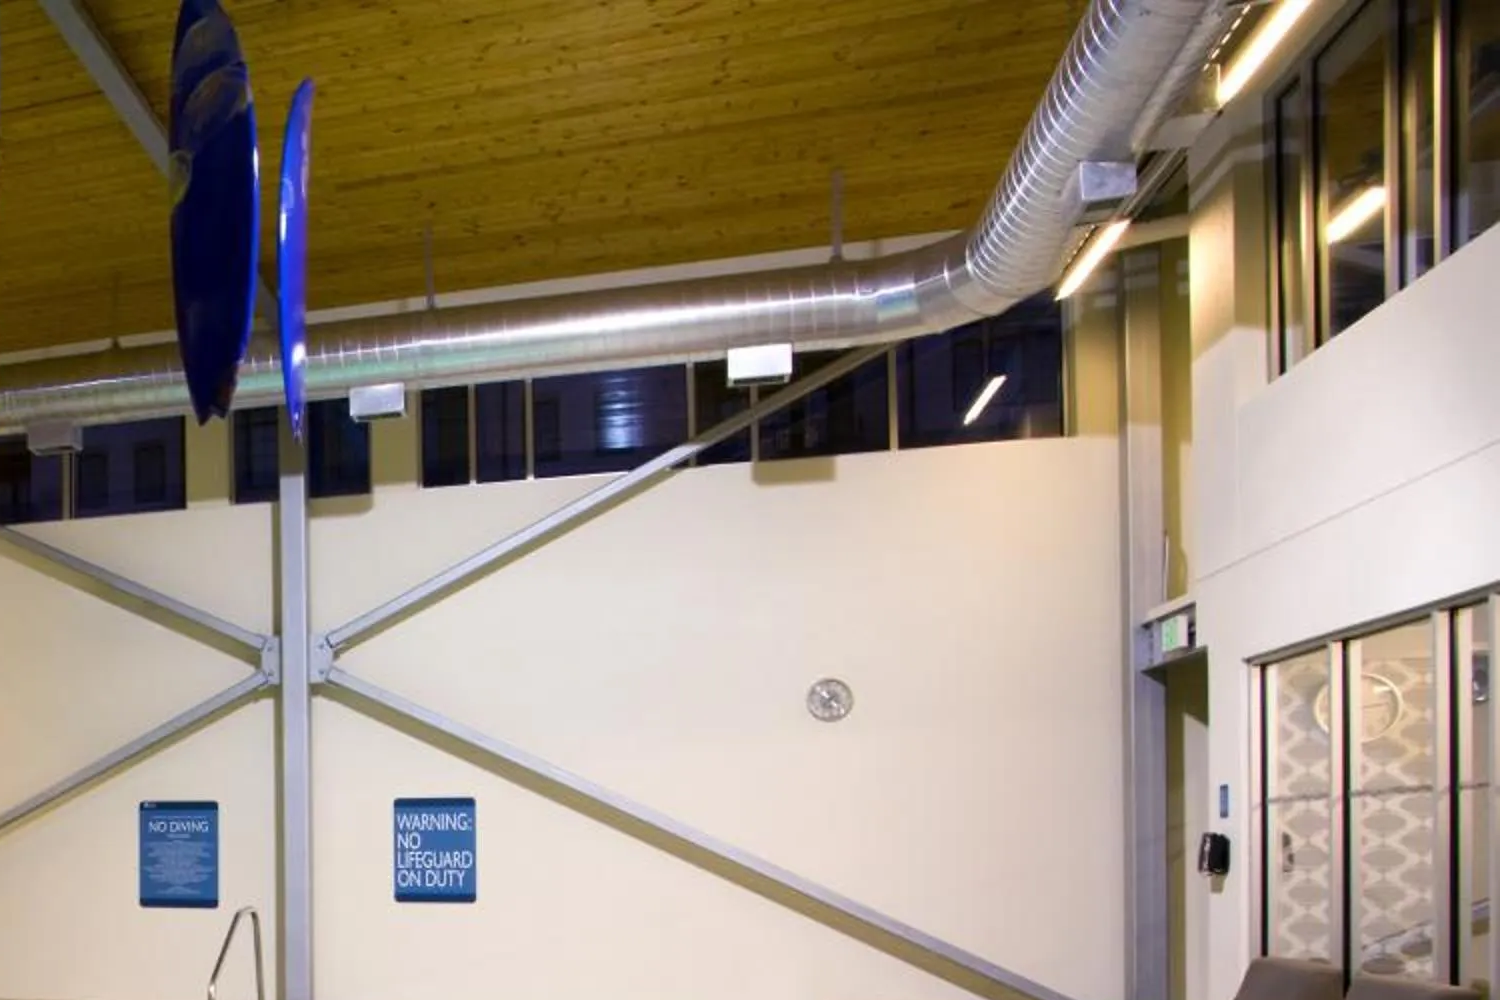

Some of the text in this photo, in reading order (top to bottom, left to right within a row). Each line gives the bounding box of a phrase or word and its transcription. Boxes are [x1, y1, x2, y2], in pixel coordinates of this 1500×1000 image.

[149, 821, 209, 833] NO DIVING
[396, 813, 473, 831] WARNING:
[397, 832, 421, 849] NO
[397, 851, 473, 869] LIFEGUARD
[397, 869, 466, 887] ON DUTY
